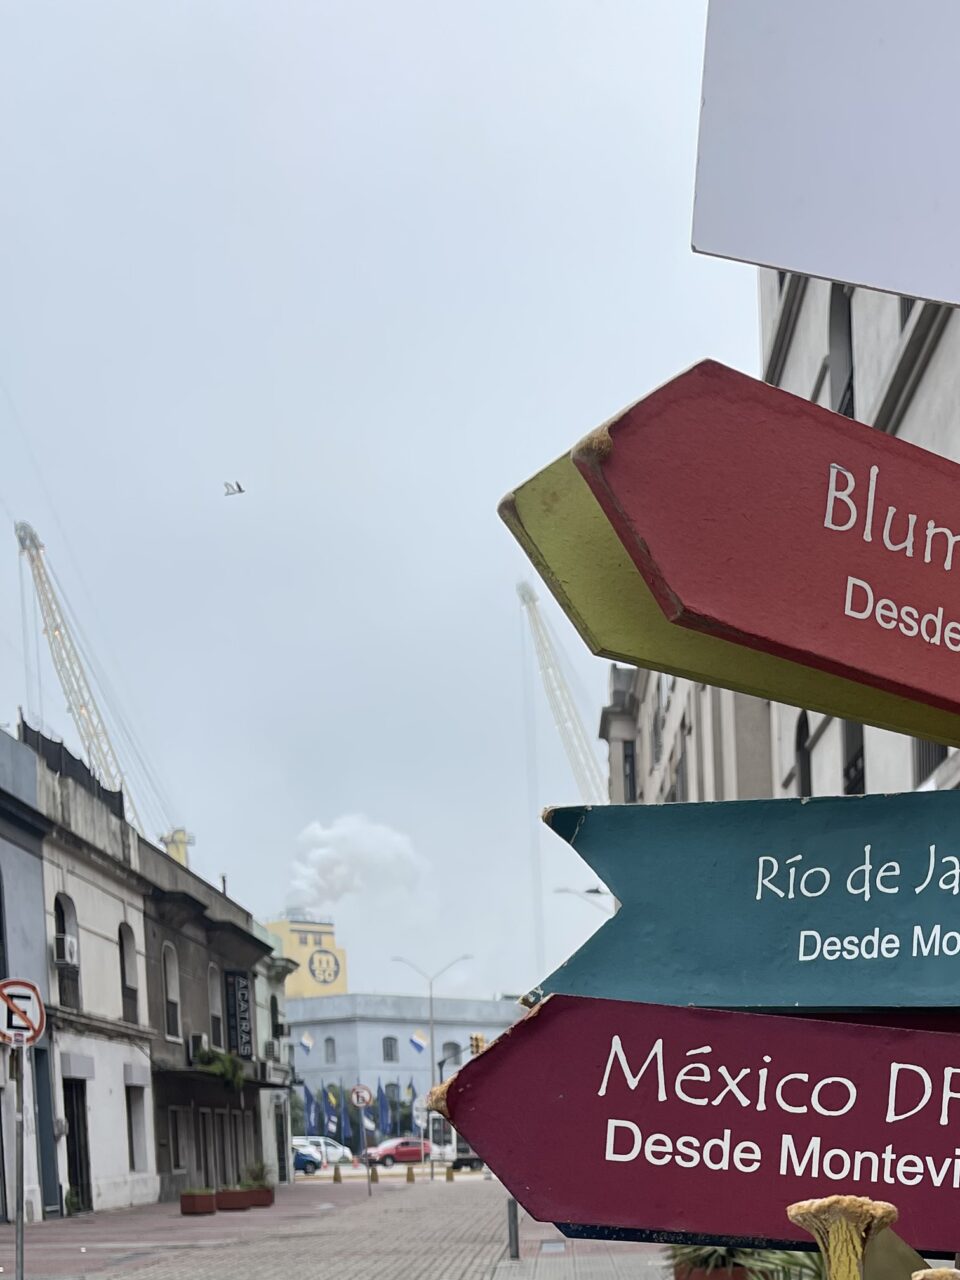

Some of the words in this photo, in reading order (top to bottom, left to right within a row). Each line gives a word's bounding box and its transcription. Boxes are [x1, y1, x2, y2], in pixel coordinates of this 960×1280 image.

[754, 842, 831, 901] Río
[846, 843, 901, 902] de
[798, 927, 900, 961] Desde
[597, 1035, 857, 1116] México
[605, 1118, 762, 1173] Desde
